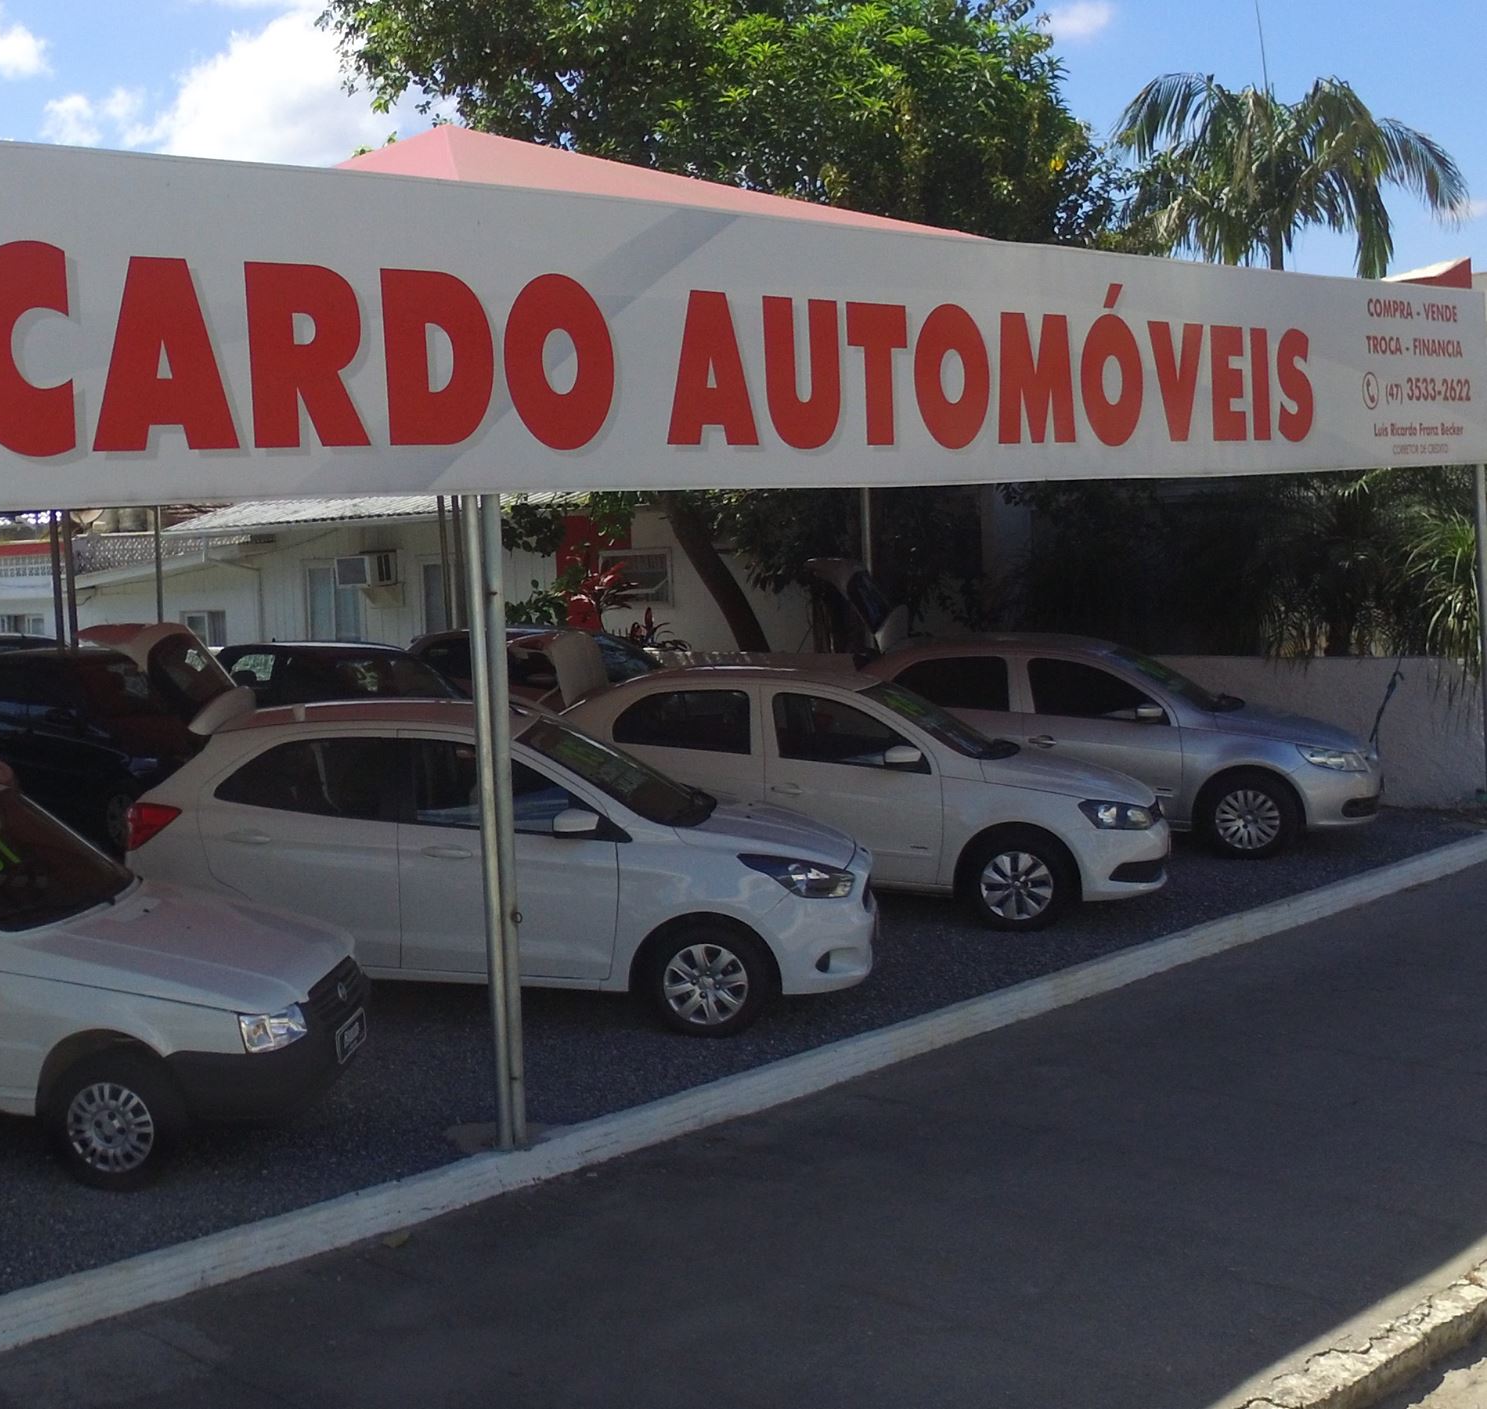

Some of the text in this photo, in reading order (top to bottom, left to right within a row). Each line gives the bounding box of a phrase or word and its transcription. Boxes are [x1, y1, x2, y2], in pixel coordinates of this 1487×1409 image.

[1367, 298, 1413, 319] COMPRA
[1423, 303, 1458, 322] VENDE
[1366, 336, 1403, 355] TROCA
[1413, 339, 1463, 357] FINANCIA
[667, 283, 1315, 450] AUTOMÓVEIS
[1385, 377, 1471, 404] (47) 3533-2622
